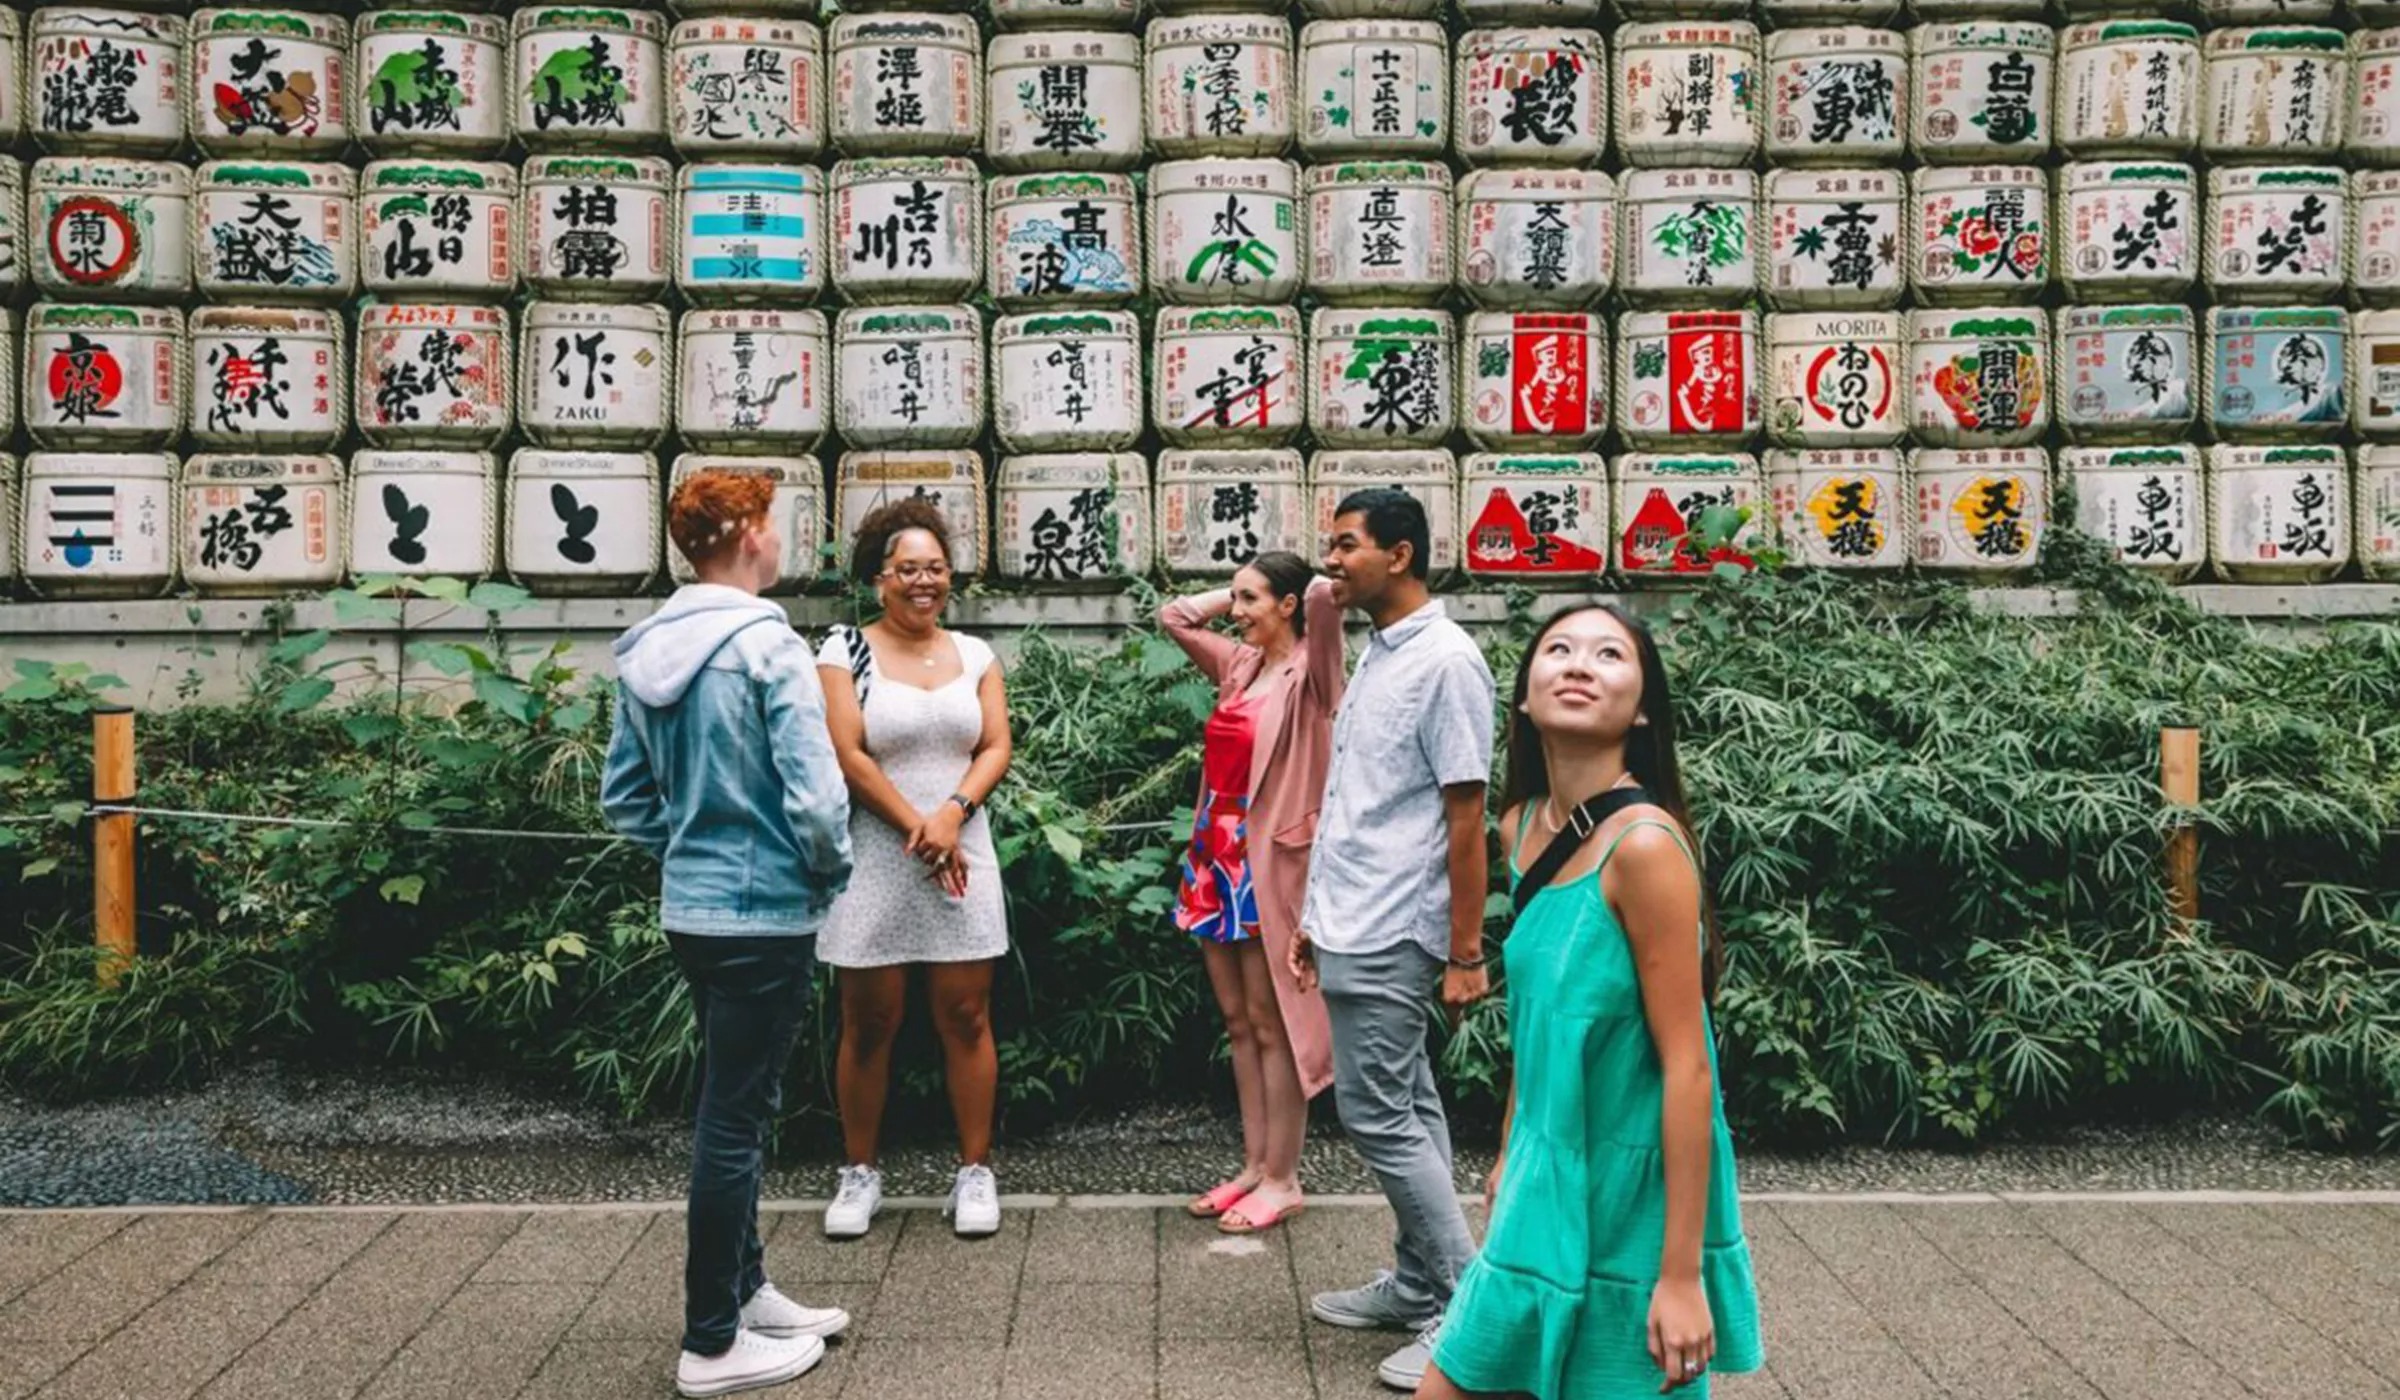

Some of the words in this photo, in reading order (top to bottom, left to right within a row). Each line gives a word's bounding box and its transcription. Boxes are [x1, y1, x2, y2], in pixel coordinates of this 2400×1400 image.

[876, 47, 926, 127] 澤姫
[1034, 65, 1099, 156] 開華
[1372, 50, 1400, 133] 十一正宗
[1687, 53, 1714, 136] 副将軍
[68, 210, 111, 274] 菊水
[553, 185, 621, 279] 柏露
[853, 180, 943, 270] 吉乃川
[1208, 194, 1256, 287] 水尾
[1984, 190, 2030, 280] 麗人
[550, 331, 616, 400] 作
[1815, 320, 1888, 337] MORITA
[314, 350, 329, 415] 日本酒
[554, 406, 608, 420] ZAKU
[1838, 342, 1870, 429] ねのひ
[1977, 342, 2019, 436] 開運
[200, 485, 293, 571] 五橋
[1478, 533, 1511, 549] FUJI
[1520, 491, 1560, 565] 富士
